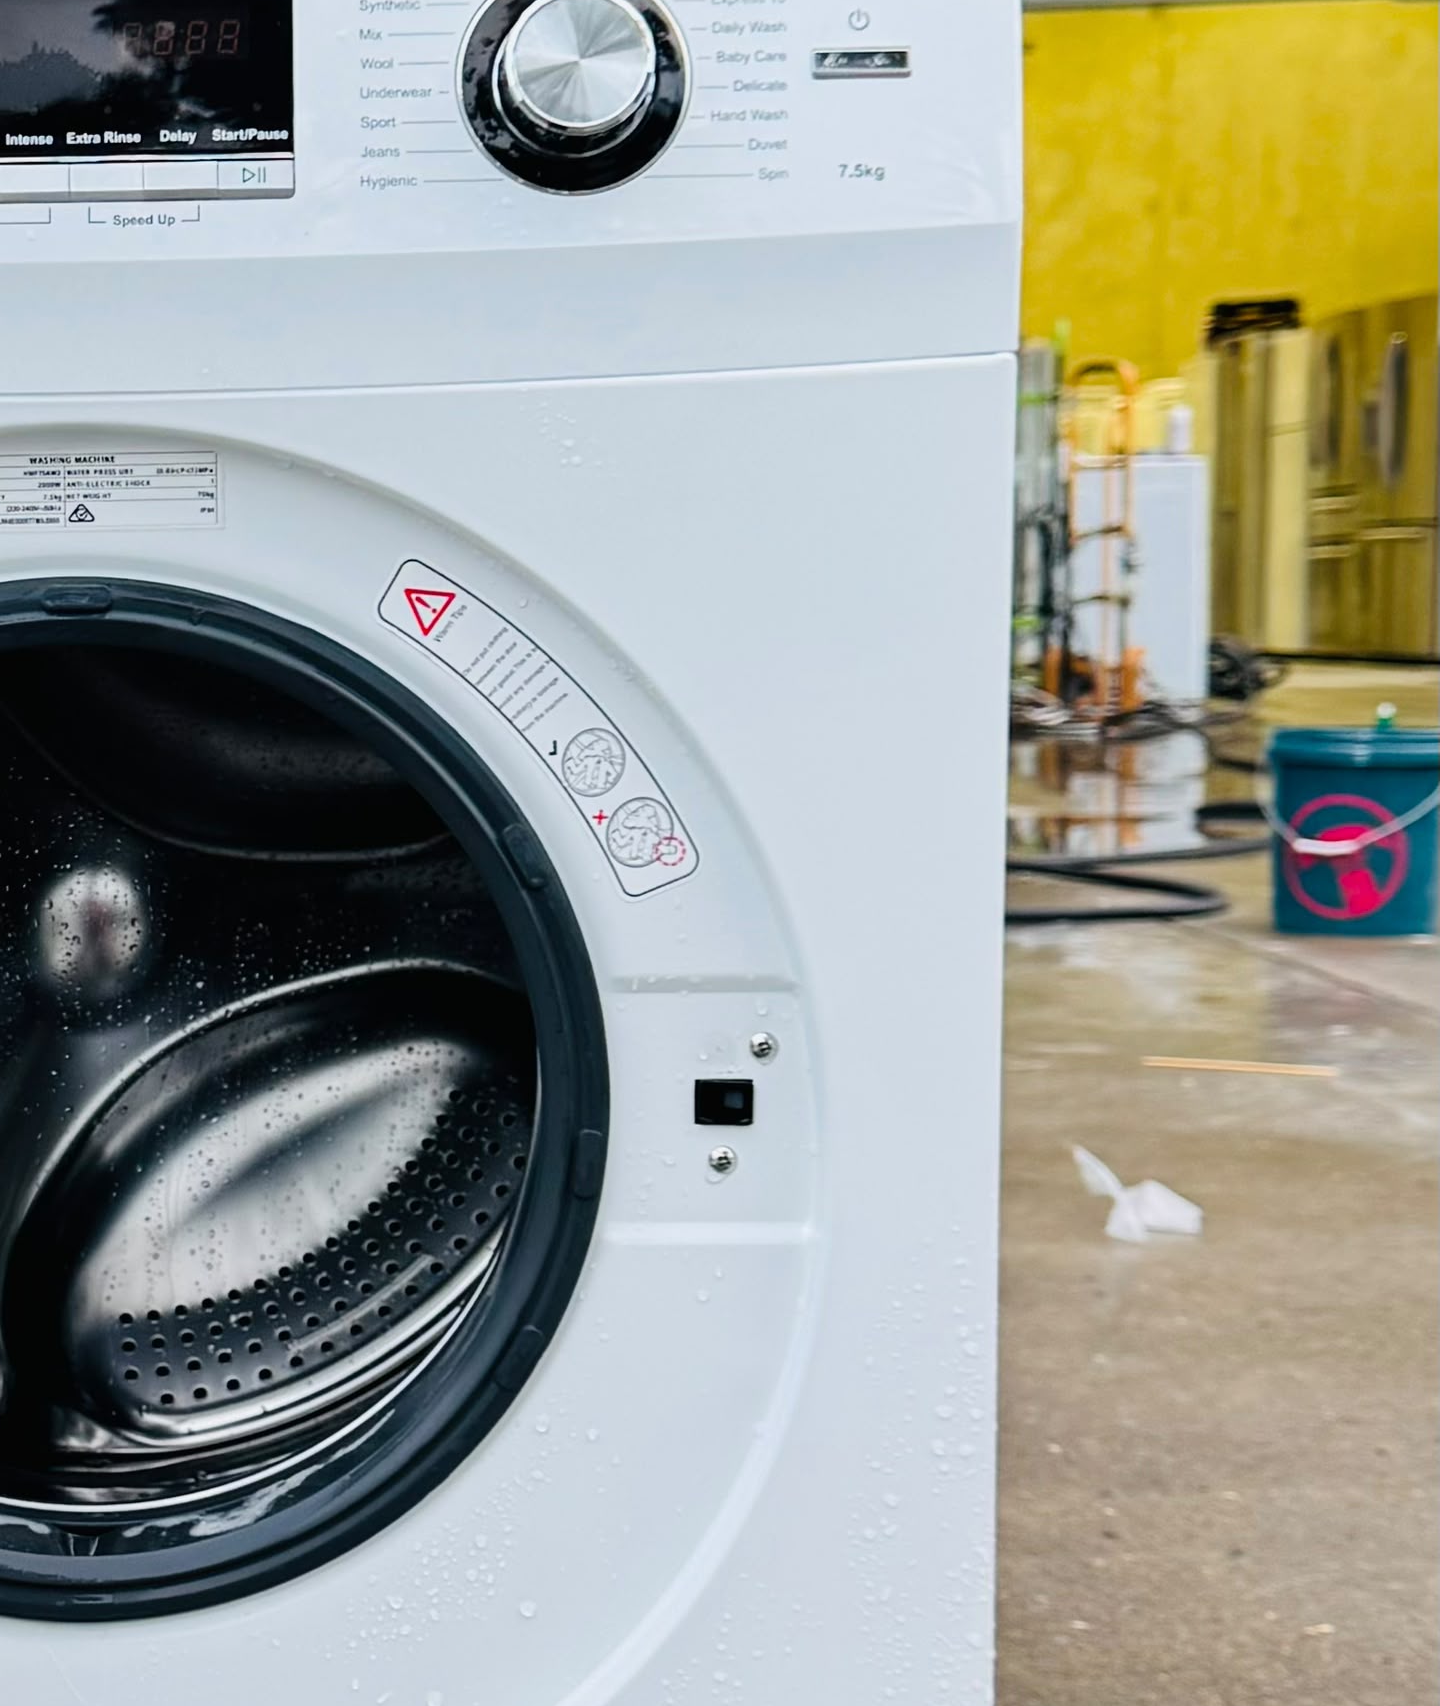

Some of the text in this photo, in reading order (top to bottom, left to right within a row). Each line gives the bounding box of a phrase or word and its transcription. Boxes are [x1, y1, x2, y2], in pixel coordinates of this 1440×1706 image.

[358, 28, 383, 41] Mix
[711, 21, 787, 36] Daily Wash
[359, 57, 394, 70] Wool
[715, 50, 787, 66] Baby Care
[732, 79, 788, 92] Delicate
[359, 86, 432, 99] Underwear
[709, 109, 789, 122] Hand Wash
[359, 116, 397, 131] Sport
[5, 133, 54, 146] Intense
[66, 131, 141, 144] Extra Rinse
[159, 129, 197, 145] Delay
[211, 127, 289, 141] Start/Pause
[747, 138, 788, 151] Duvet
[361, 145, 401, 158] Jeans
[757, 168, 789, 182] Spin
[837, 163, 885, 181] 7.5kg
[359, 174, 418, 189] Hygienic
[112, 213, 175, 227] Speed Up
[74, 456, 115, 464] MACHINE
